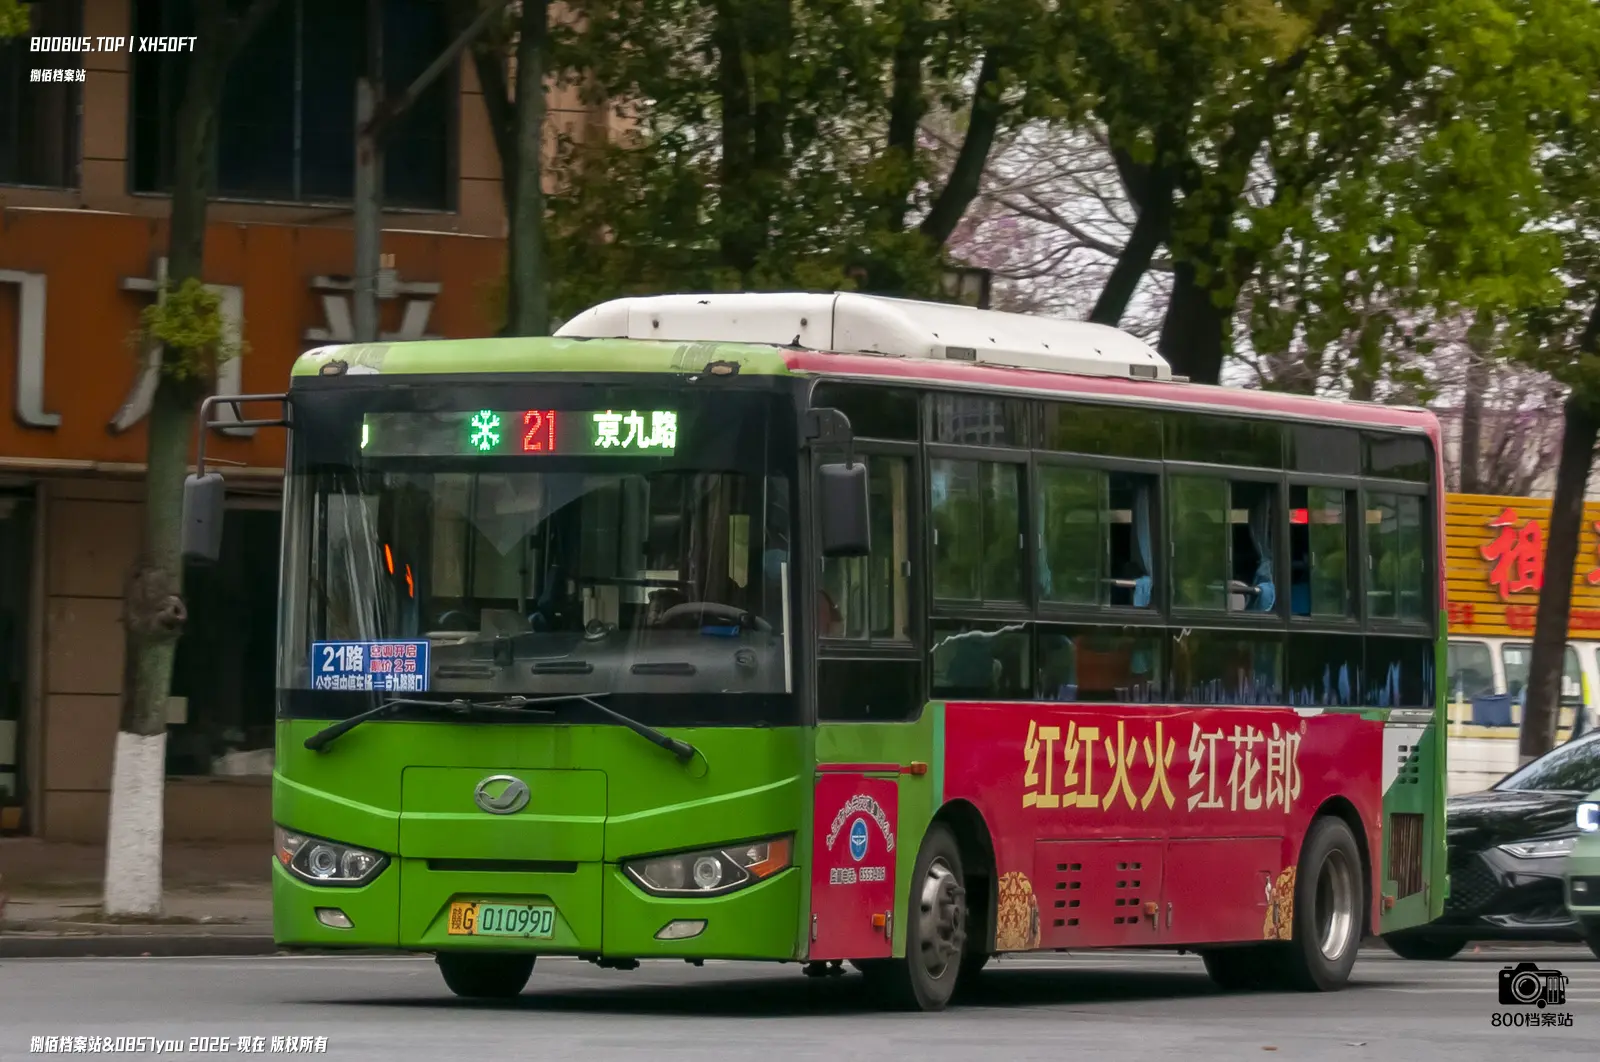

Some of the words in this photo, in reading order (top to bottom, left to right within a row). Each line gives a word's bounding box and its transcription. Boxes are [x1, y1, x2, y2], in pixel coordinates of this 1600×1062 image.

[523, 410, 556, 451] 21
[593, 410, 678, 449] 京九路
[322, 645, 364, 672] 21路
[370, 644, 417, 658] 空调开启
[1022, 719, 1176, 811] 红红火火
[1187, 722, 1301, 814] 红花郎
